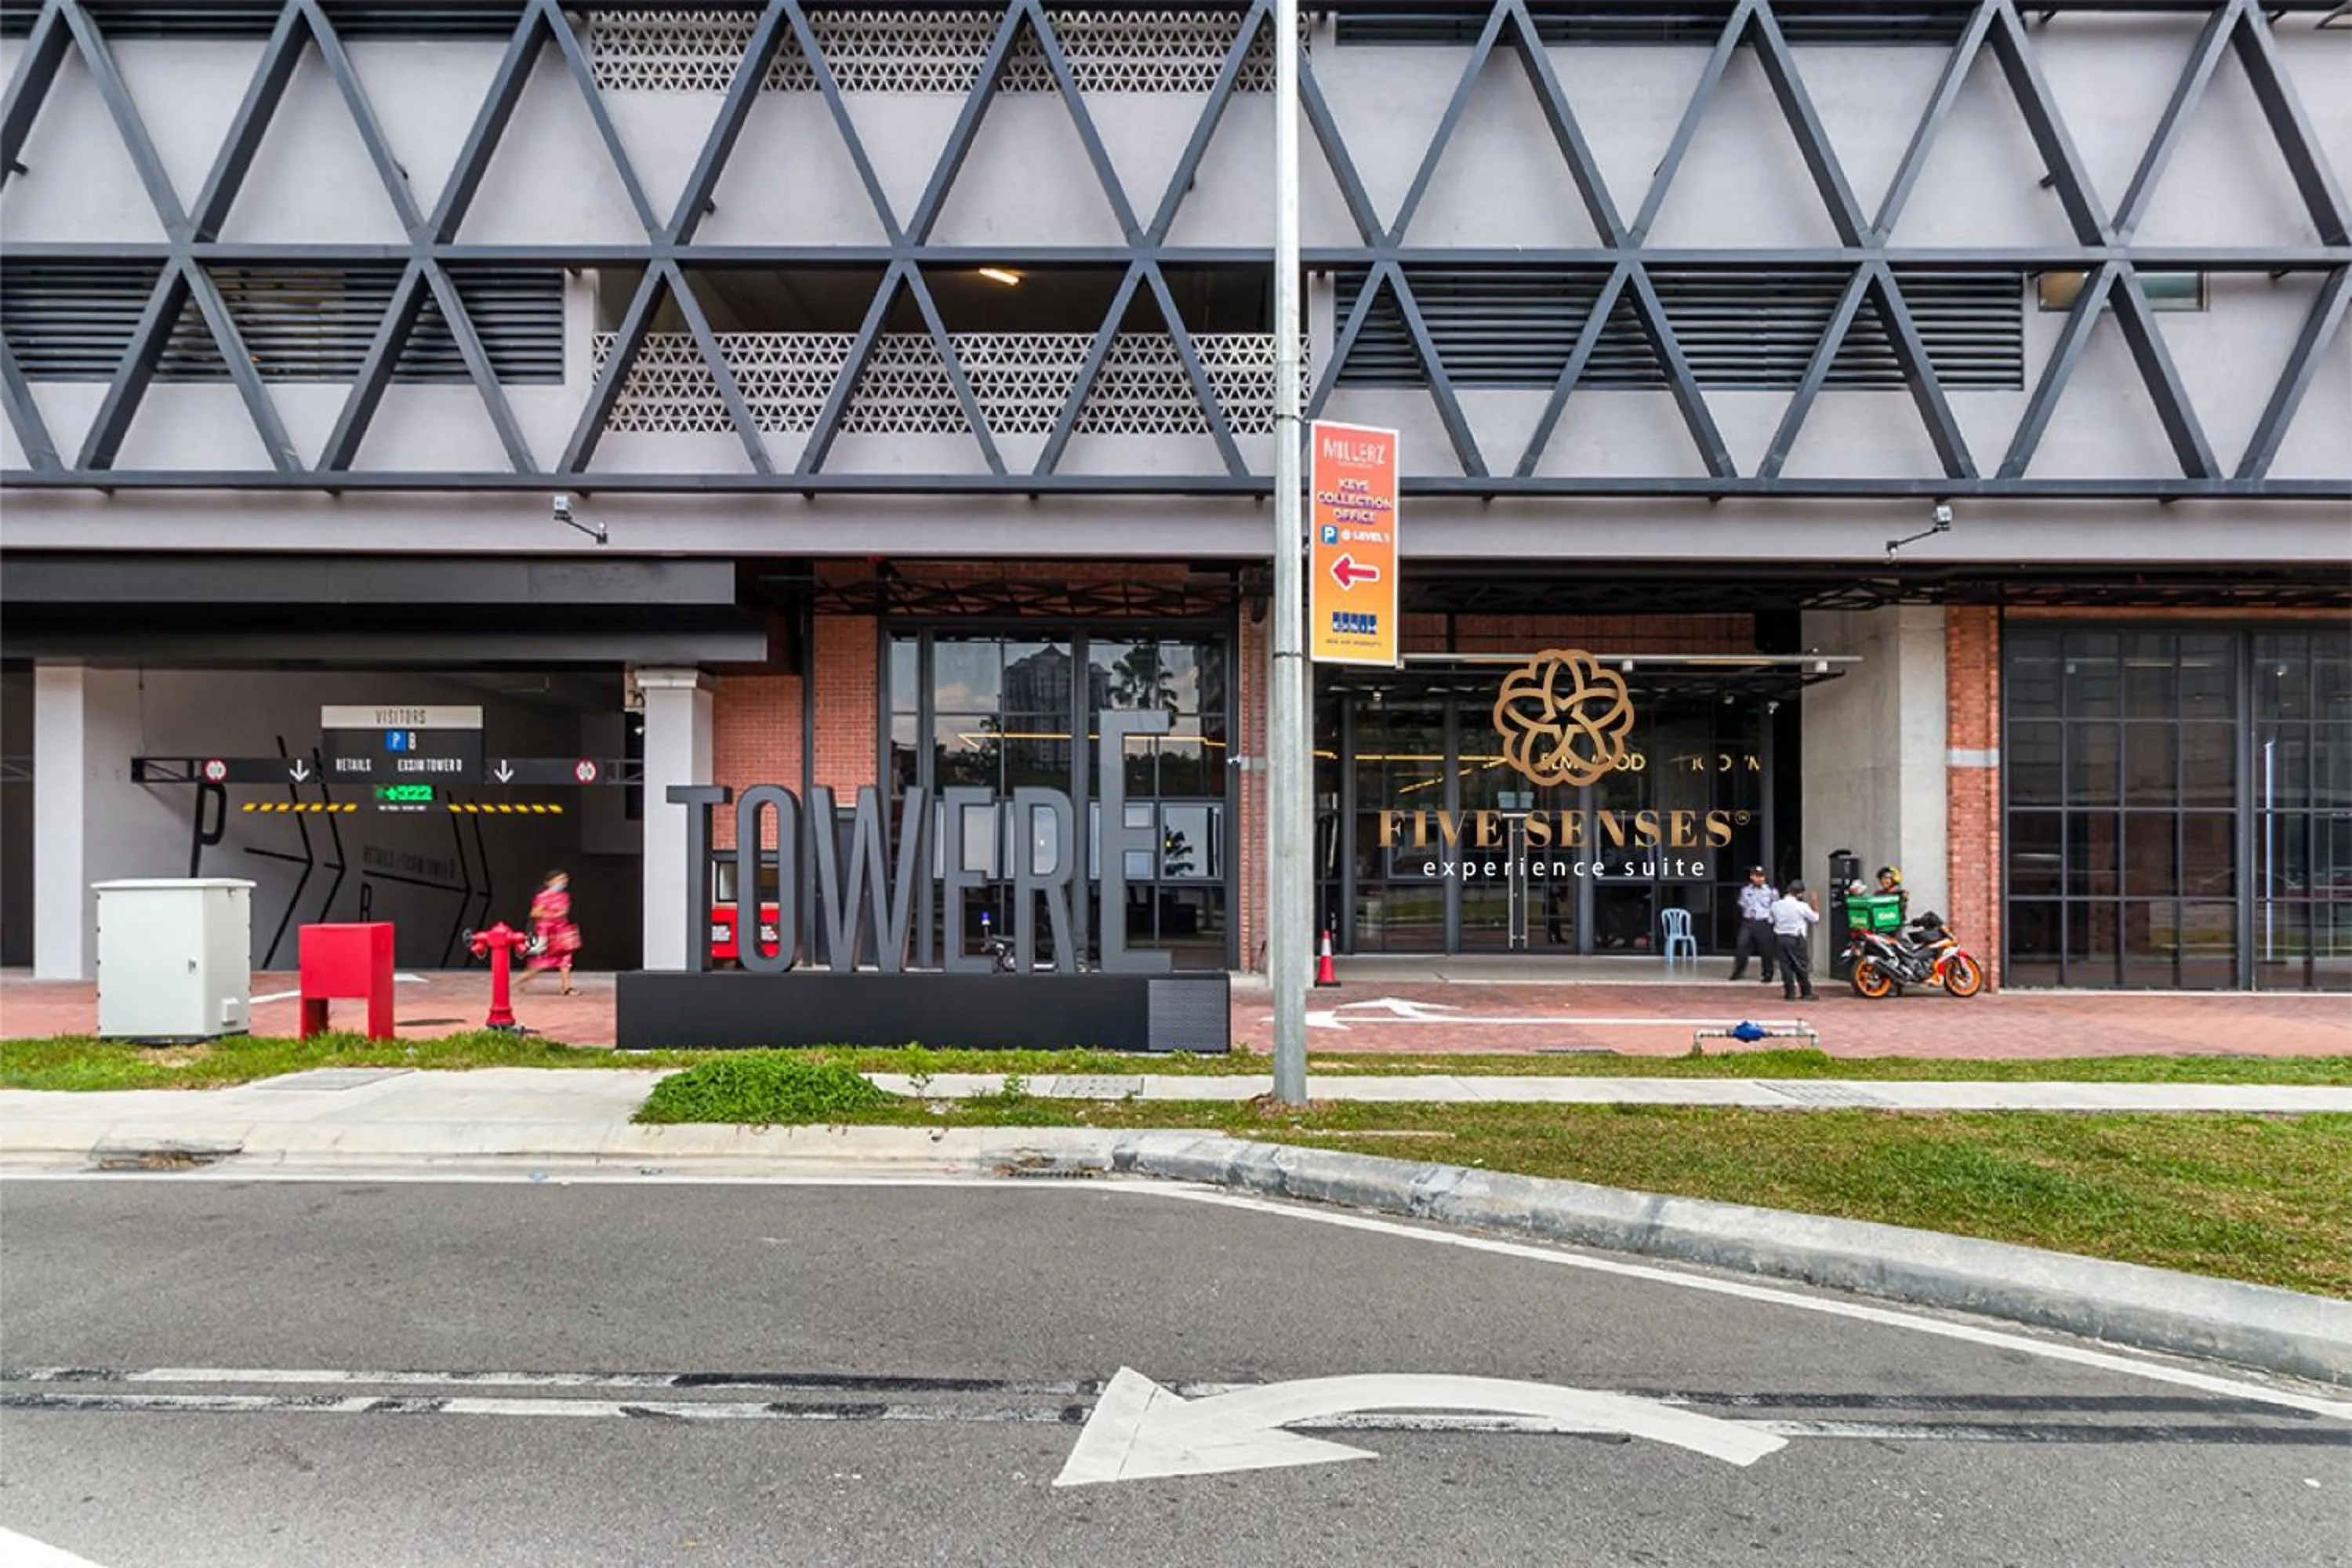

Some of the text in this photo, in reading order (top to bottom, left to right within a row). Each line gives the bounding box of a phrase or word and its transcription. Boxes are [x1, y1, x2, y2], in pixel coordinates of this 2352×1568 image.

[1323, 437, 1386, 464] MILLERZ
[1317, 490, 1392, 510] COLLECTION
[376, 709, 426, 724] VISITORS
[666, 709, 1173, 973] TOWER E
